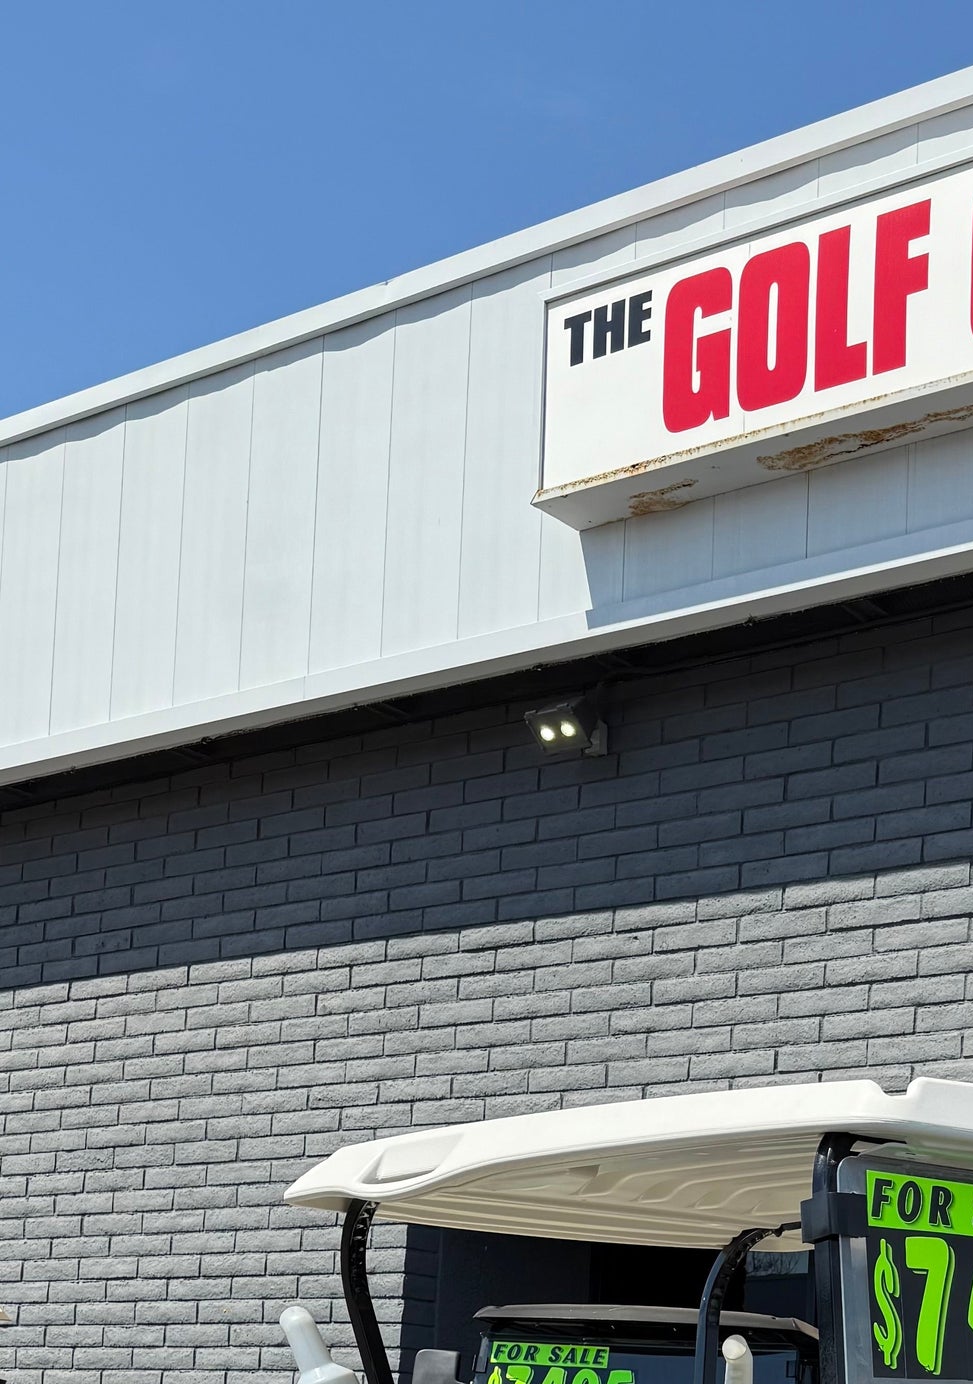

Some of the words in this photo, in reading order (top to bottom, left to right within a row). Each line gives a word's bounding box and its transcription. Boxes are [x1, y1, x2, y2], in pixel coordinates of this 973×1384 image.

[564, 290, 652, 367] THE
[663, 199, 930, 433] GOLF
[871, 1178, 952, 1228] FOR
[493, 1343, 540, 1363] FOR
[548, 1346, 607, 1366] SALE
